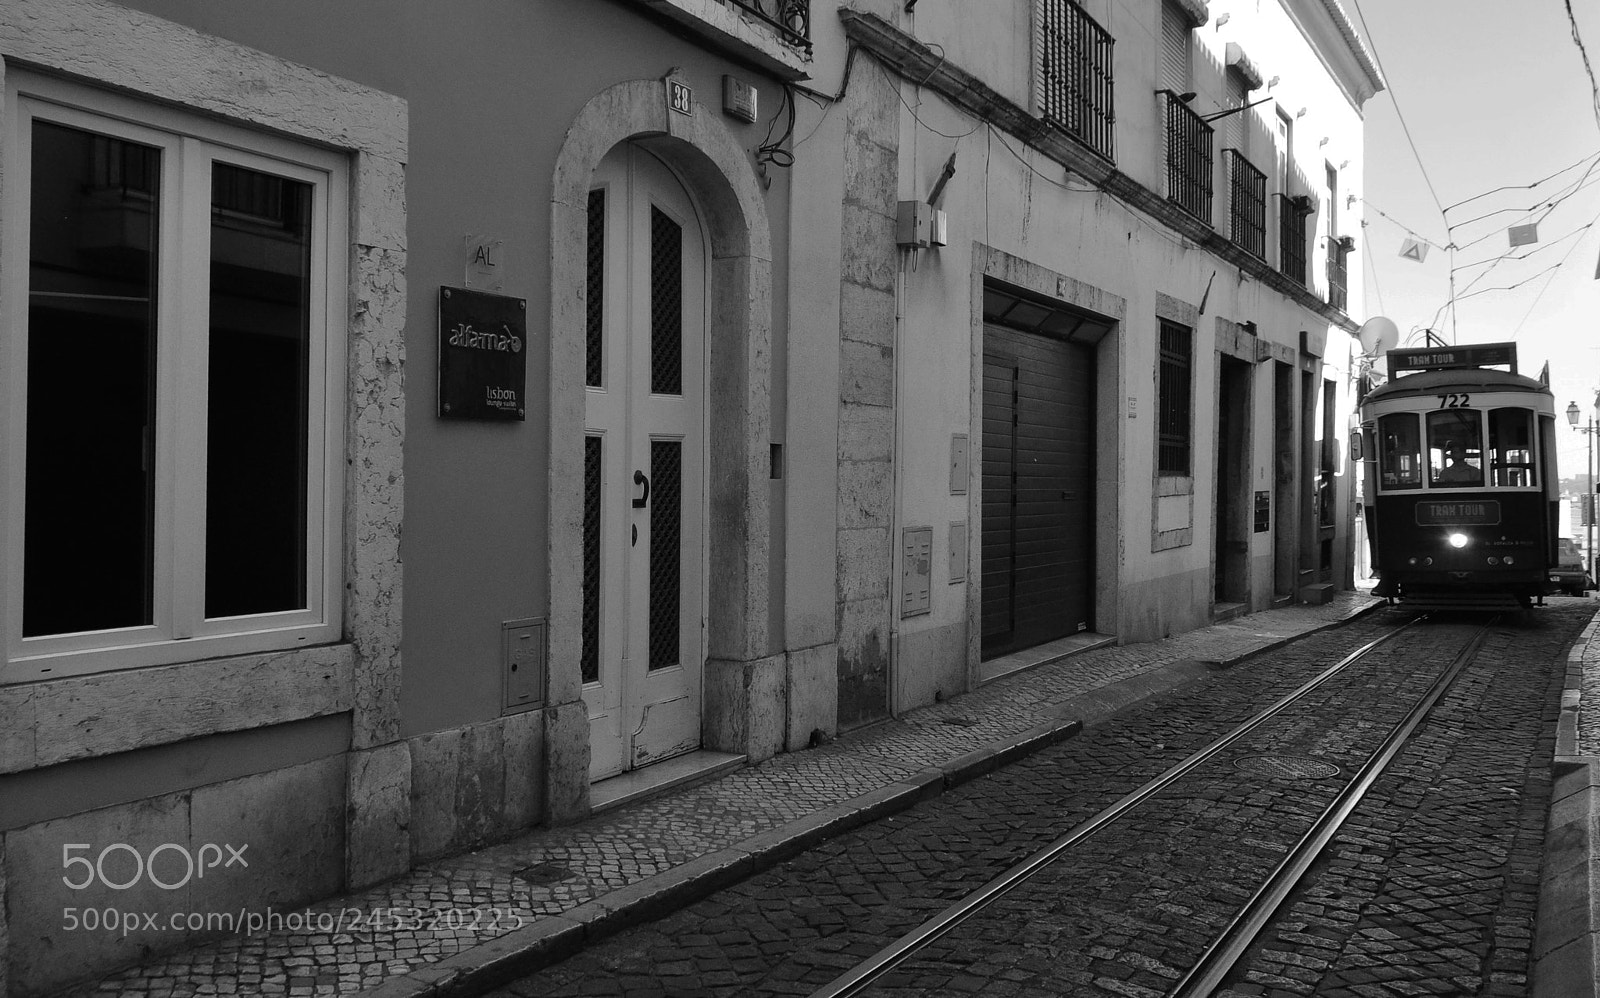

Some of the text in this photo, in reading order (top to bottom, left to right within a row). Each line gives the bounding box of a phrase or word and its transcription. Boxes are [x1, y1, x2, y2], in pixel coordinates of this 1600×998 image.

[674, 85, 688, 111] 38
[474, 245, 495, 266] AL
[449, 323, 510, 352] alfama
[1408, 353, 1455, 366] TRAM TOUR
[486, 385, 516, 400] lisbon
[1437, 394, 1470, 408] 722
[1430, 504, 1485, 516] TRAM TOUR
